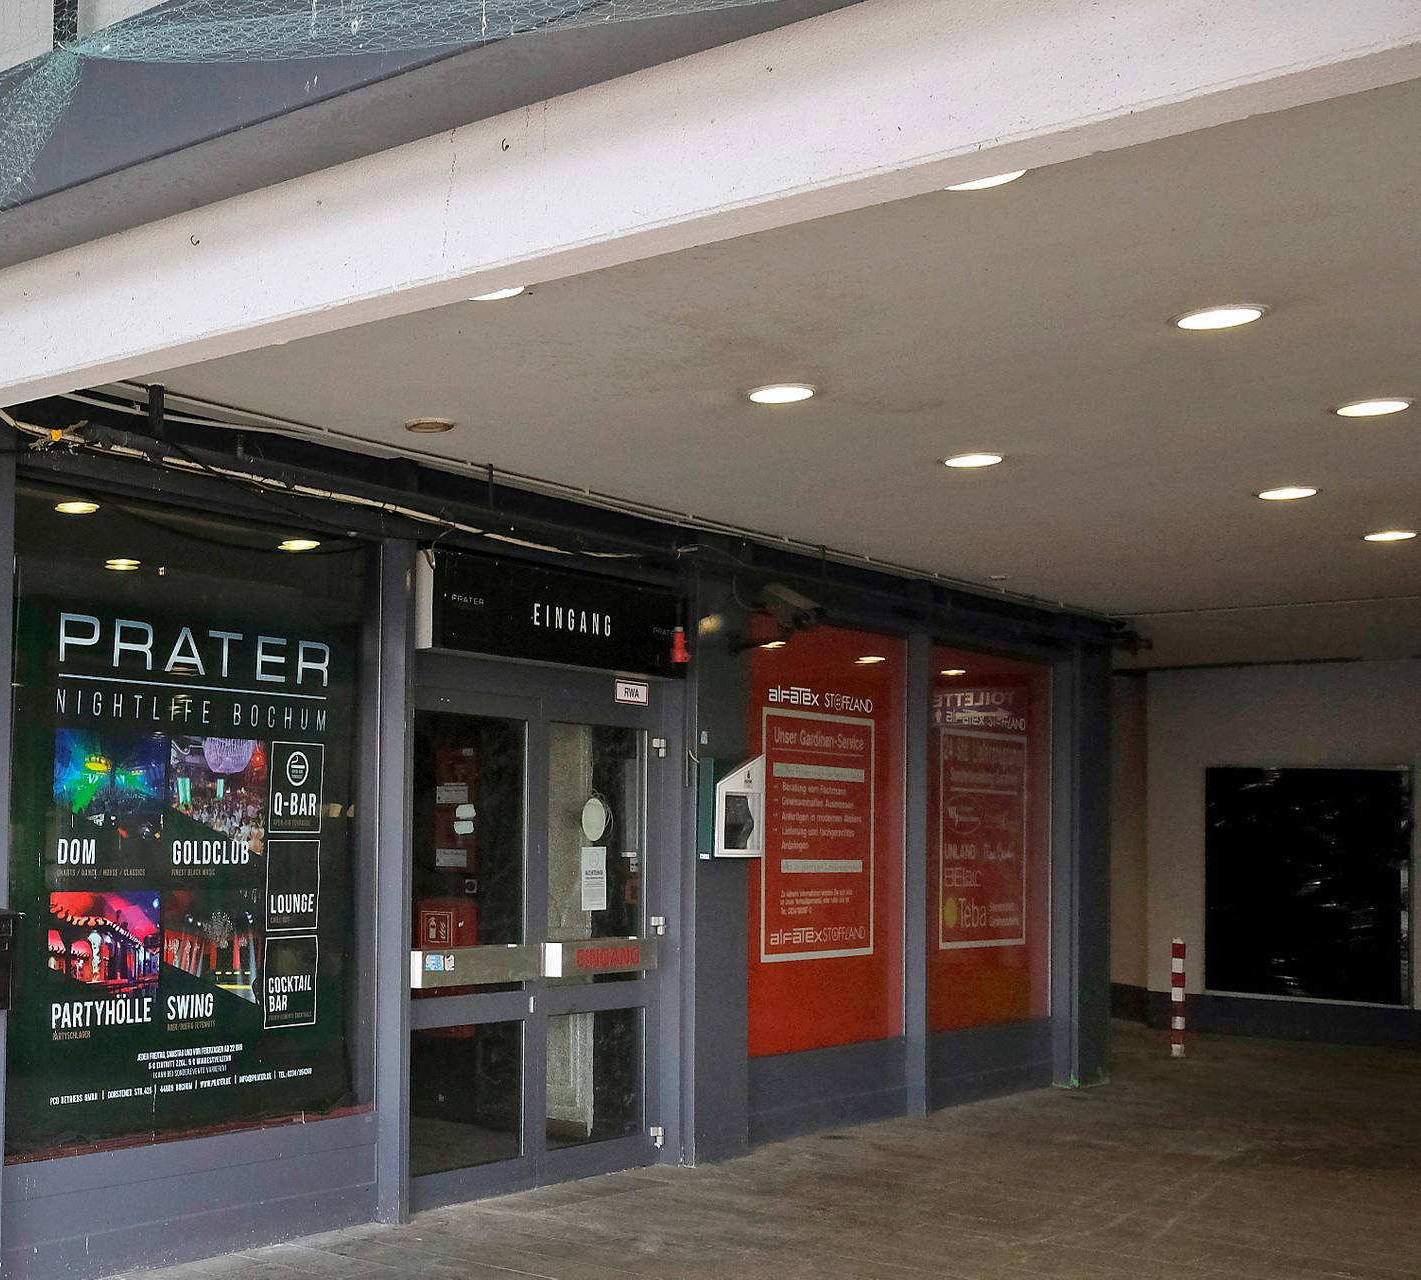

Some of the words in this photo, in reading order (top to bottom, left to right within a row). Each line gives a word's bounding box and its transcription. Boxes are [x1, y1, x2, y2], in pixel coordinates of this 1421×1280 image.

[451, 593, 484, 605] PRATER
[533, 603, 611, 637] EINGANG
[58, 612, 330, 687] PRATER
[624, 687, 640, 699] RWA
[56, 688, 211, 724] NIGHTLIFE
[233, 702, 327, 732] BOCHUM
[274, 791, 317, 817] Q-BAR
[57, 837, 96, 865] DOM
[172, 839, 250, 865] GOLDCLUB
[270, 893, 315, 914] LOUNGE
[958, 897, 987, 928] Teba
[268, 974, 312, 994] COCKTAIL
[51, 993, 152, 1030] PARTYHÖLLE
[166, 992, 214, 1021] SWING
[268, 994, 288, 1013] BAR
